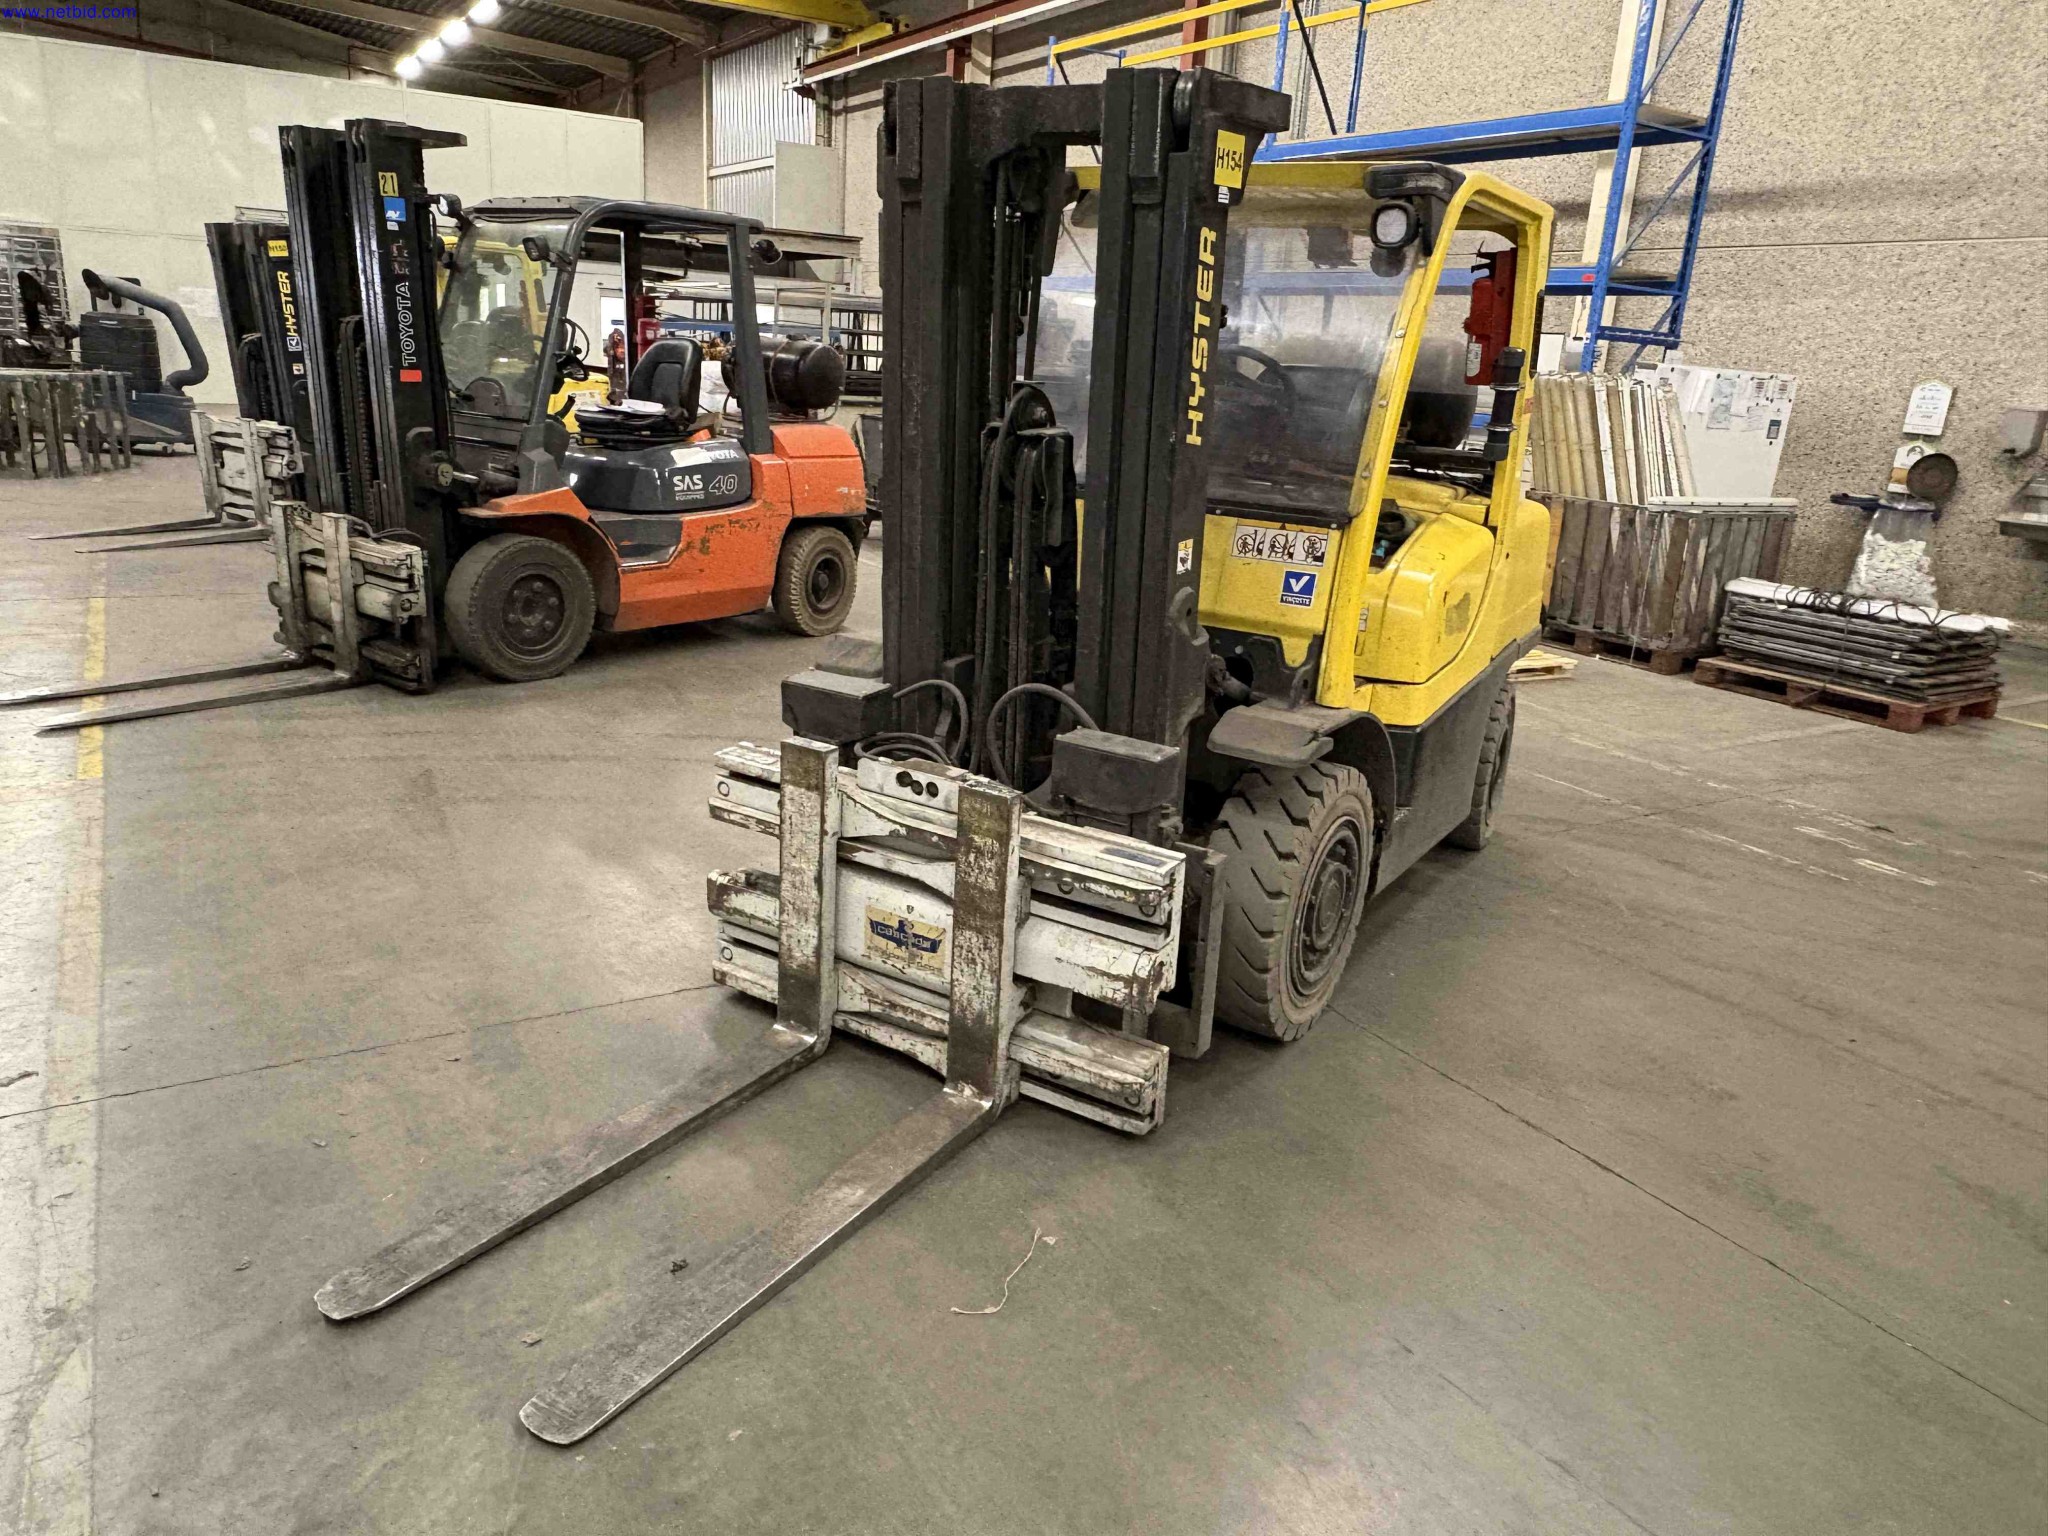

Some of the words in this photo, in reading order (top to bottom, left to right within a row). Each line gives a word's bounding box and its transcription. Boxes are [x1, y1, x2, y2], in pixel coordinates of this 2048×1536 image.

[1216, 147, 1243, 172] H154
[381, 174, 396, 195] 21
[277, 270, 296, 337] HYSTER
[396, 282, 416, 366] TOYOTA
[1186, 226, 1216, 445] HYSTER
[673, 474, 704, 491] SAS
[708, 473, 738, 495] 40
[877, 925, 931, 948] cascd
